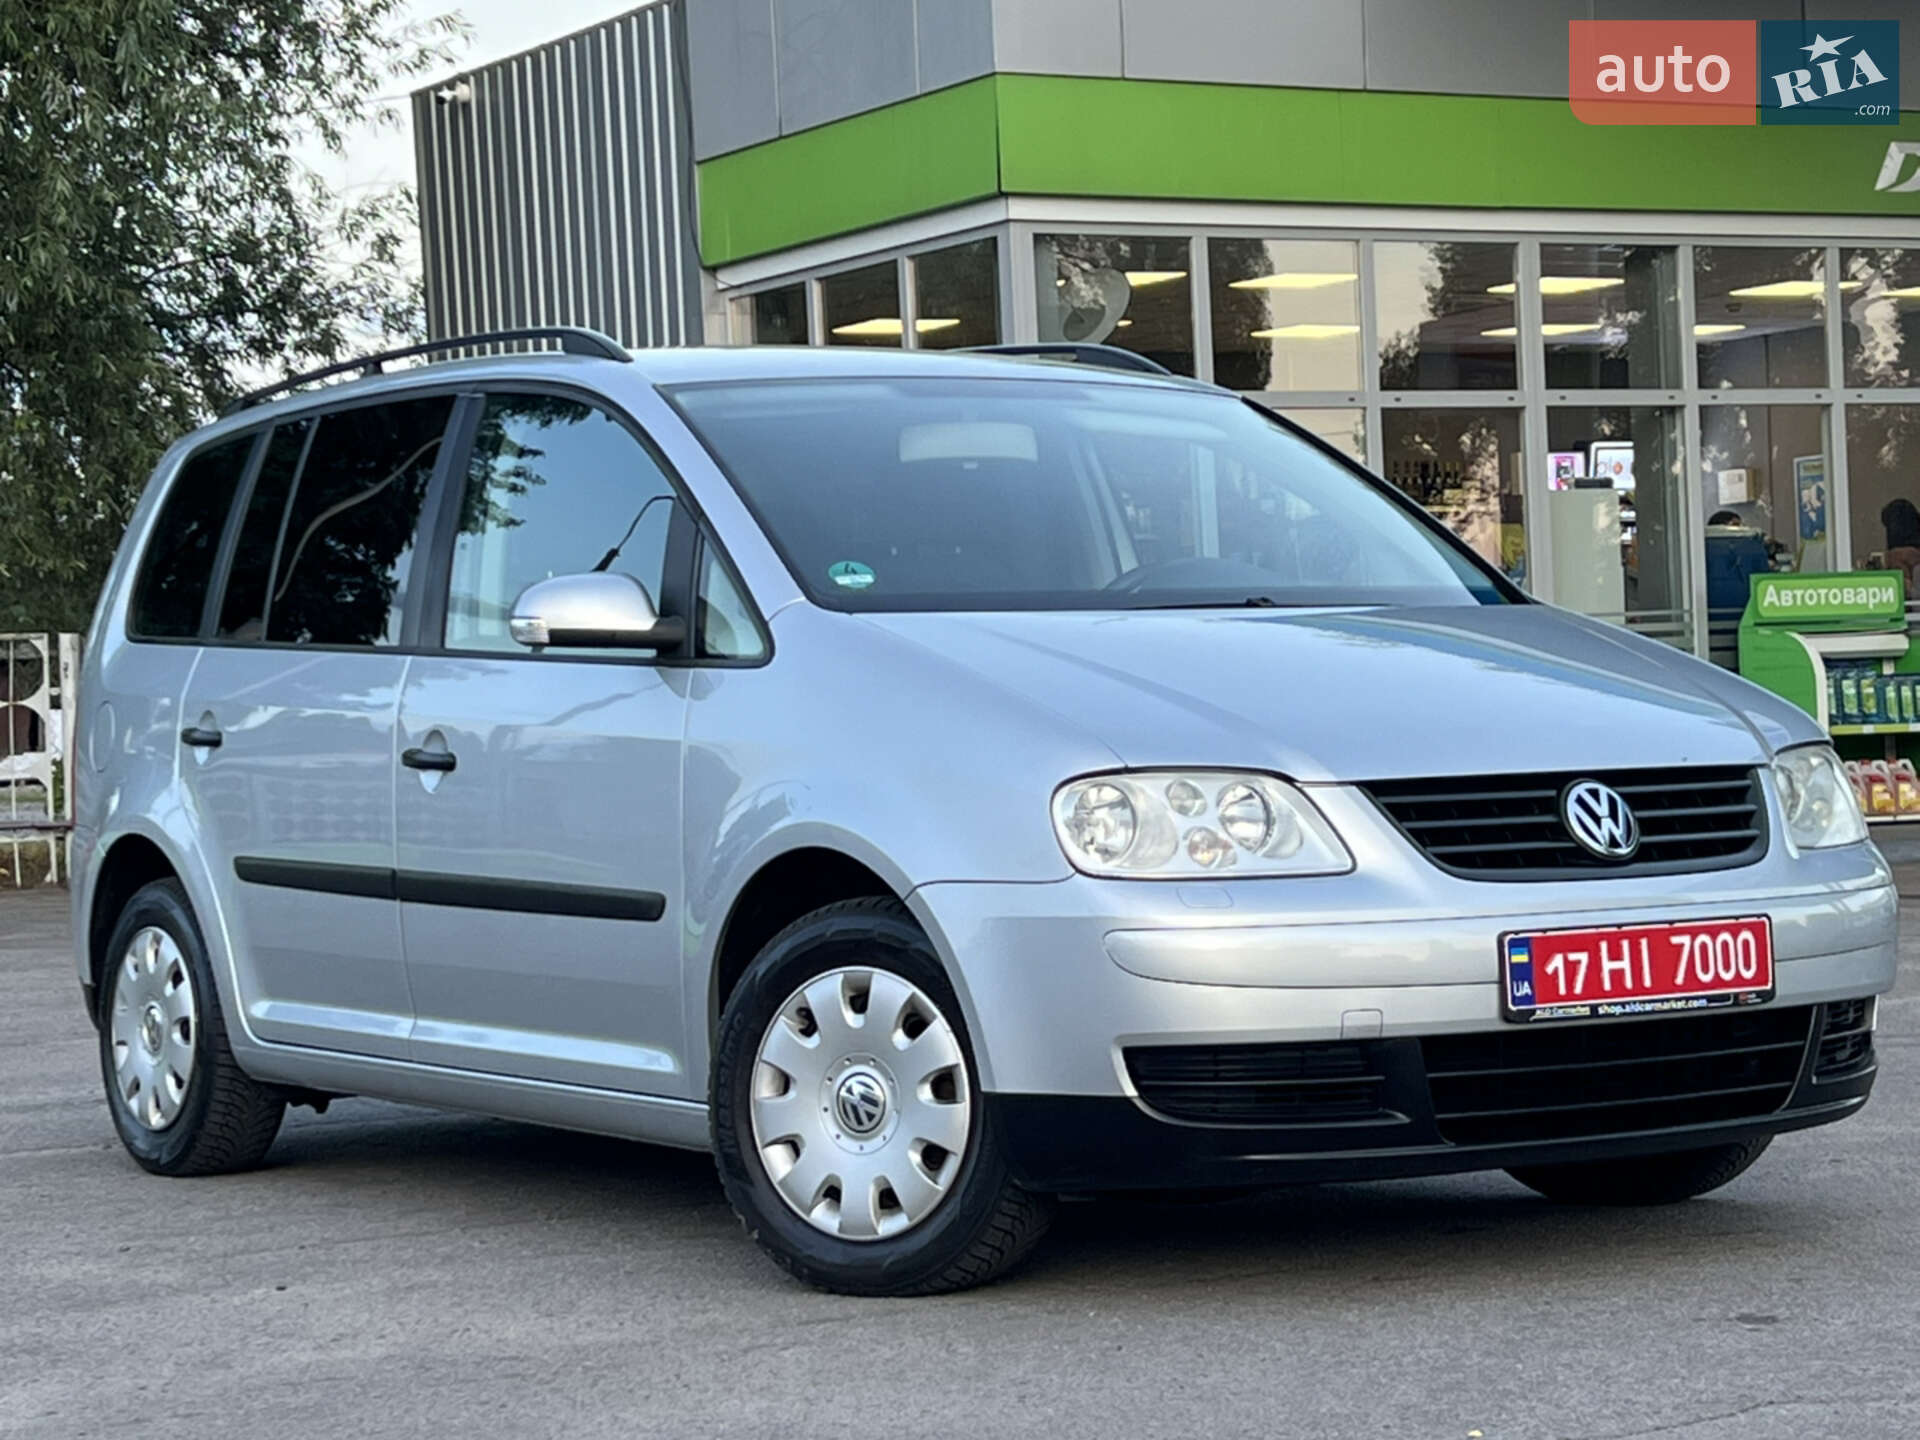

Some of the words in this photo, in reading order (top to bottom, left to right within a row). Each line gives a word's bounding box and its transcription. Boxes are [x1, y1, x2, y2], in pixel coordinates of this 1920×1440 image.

[1763, 584, 1894, 609] Автотовари
[1545, 951, 1589, 996] 17
[1600, 937, 1652, 991] HI
[1670, 929, 1757, 986] 7000
[1513, 981, 1532, 996] UA
